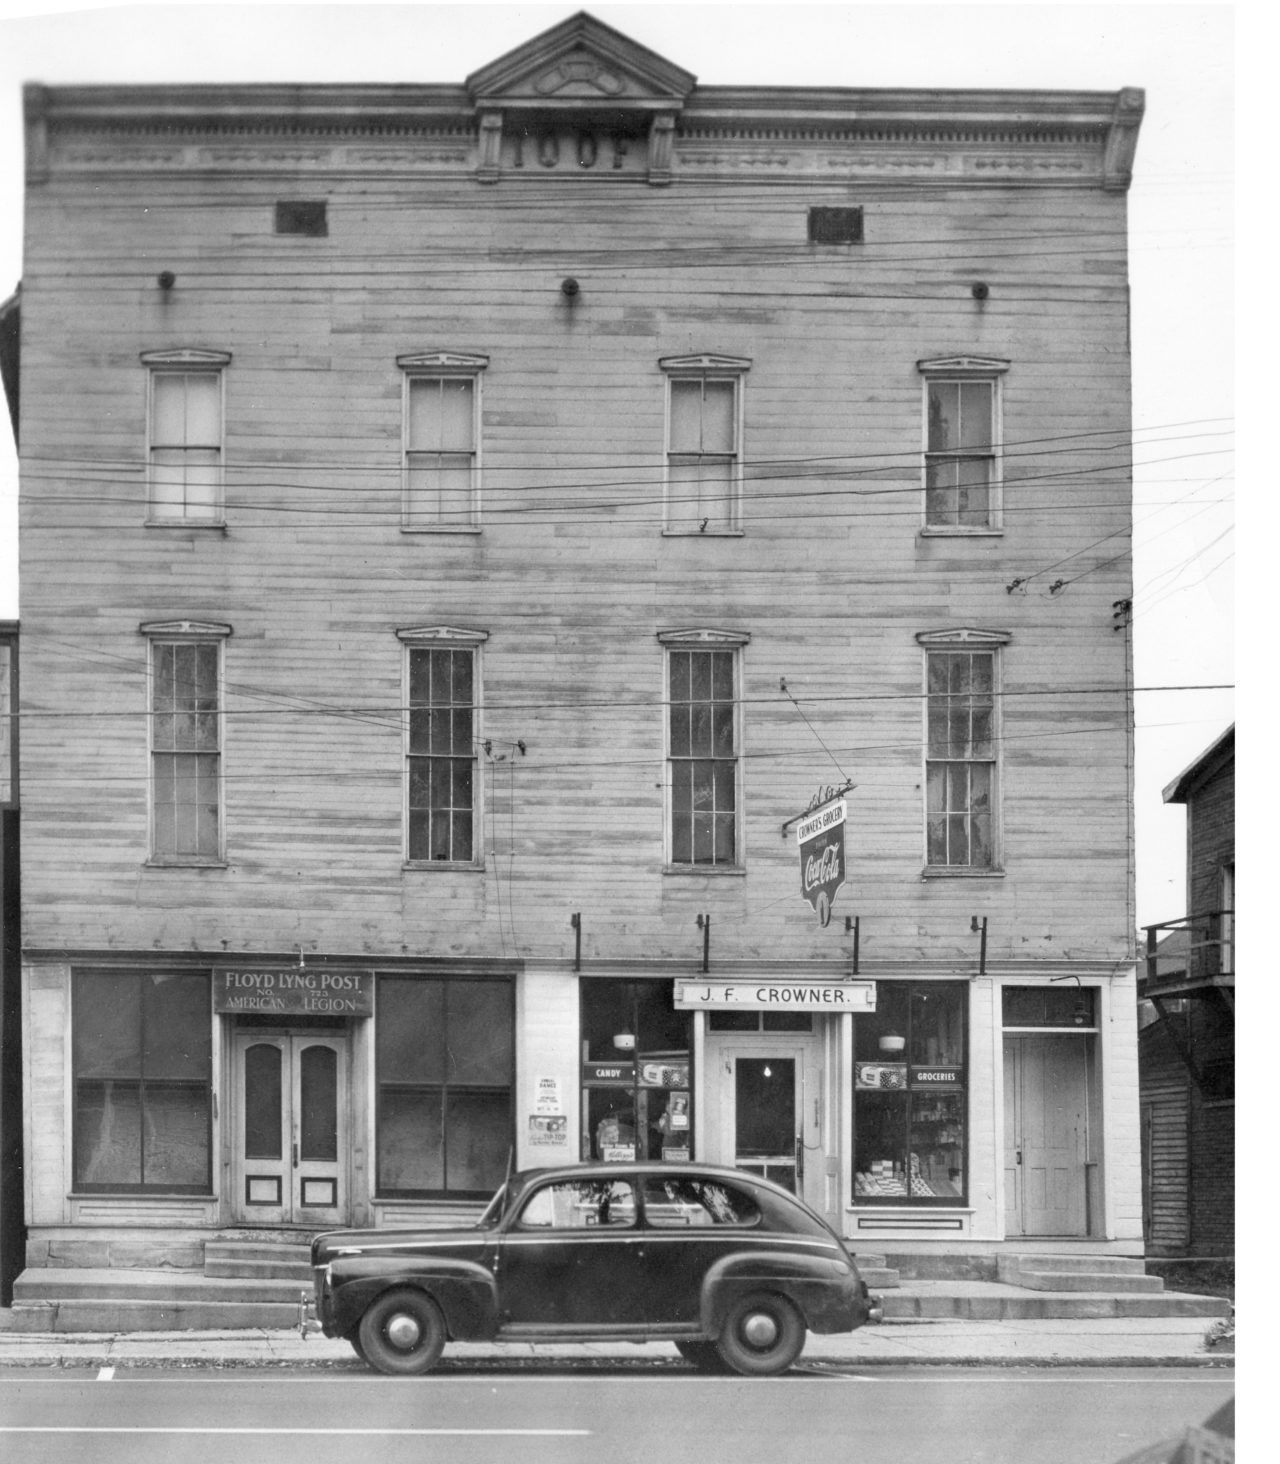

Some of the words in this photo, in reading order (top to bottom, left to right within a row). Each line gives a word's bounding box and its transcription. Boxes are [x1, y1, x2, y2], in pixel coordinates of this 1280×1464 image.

[225, 972, 274, 988] FLOYD
[279, 973, 316, 989] LYNG
[321, 974, 361, 990] POST
[700, 987, 714, 1001] J.
[724, 987, 738, 1001] F.
[225, 996, 285, 1010] AMERICAN
[304, 997, 356, 1011] LEGION
[596, 1069, 621, 1078] CANDY
[917, 1072, 956, 1081] GROCERIES
